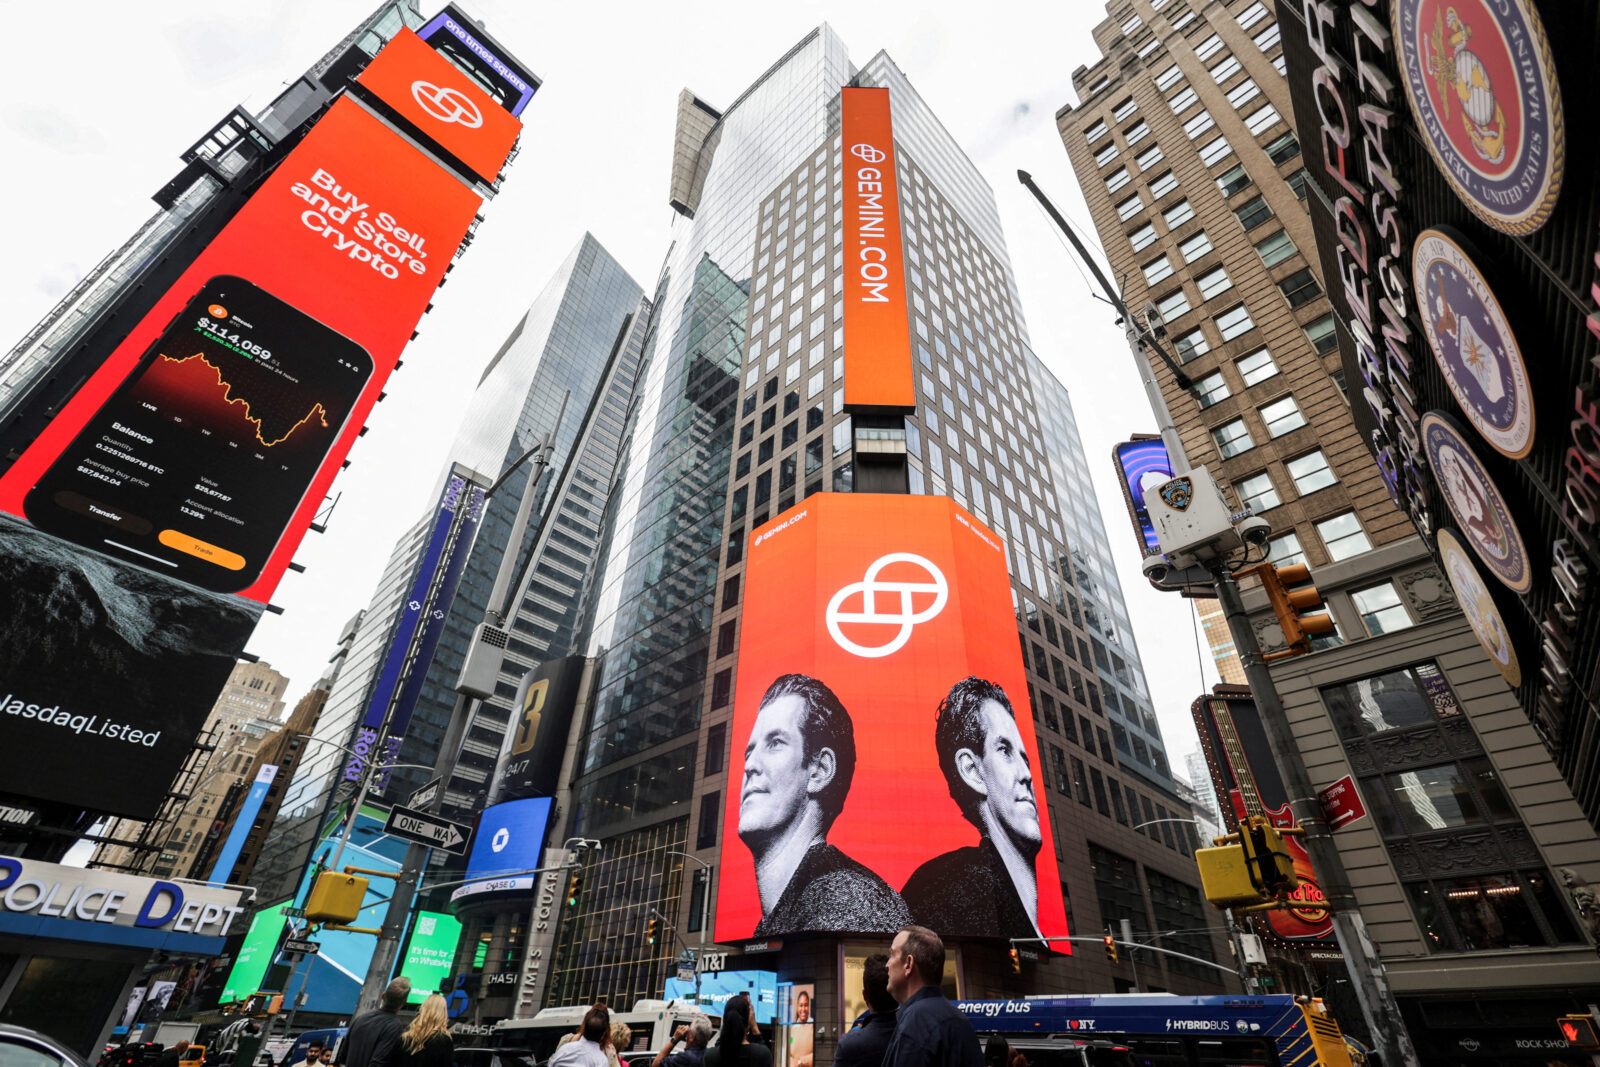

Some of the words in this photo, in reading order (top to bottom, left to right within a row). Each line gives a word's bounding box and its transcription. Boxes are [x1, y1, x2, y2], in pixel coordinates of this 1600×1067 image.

[446, 20, 466, 40] one
[466, 34, 494, 63] times
[492, 58, 526, 90] square
[1508, 21, 1542, 120] MARINE
[1403, 34, 1470, 186] DEPARTMENT
[1349, 0, 1400, 258] STATI
[1520, 131, 1542, 192] STATES
[1482, 184, 1522, 206] UNITED
[310, 168, 370, 218] Buy,
[375, 212, 428, 258] Sell,
[290, 182, 352, 224] and
[353, 220, 426, 275] Store
[858, 168, 889, 302] GEMINI.COM
[301, 210, 399, 279] Crypto
[1416, 248, 1430, 275] THE
[1429, 240, 1447, 257] AIR
[1451, 250, 1494, 312] FORCE
[232, 315, 254, 329] Bitcoin
[282, 372, 299, 384] hours
[142, 402, 158, 412] LIVE
[102, 435, 134, 452] Quantity
[112, 422, 154, 445] Balance
[83, 458, 115, 474] Average
[116, 470, 130, 481] buy
[130, 476, 150, 488] price
[148, 464, 165, 475] BTC
[200, 476, 219, 488] Value
[88, 504, 122, 522] Transfer
[184, 498, 214, 514] Account
[213, 508, 245, 526] allocation
[763, 510, 808, 540] GEMINI.COM
[512, 678, 550, 756] 3
[506, 760, 530, 778] 24/7
[0, 804, 34, 826] TION
[400, 817, 424, 834] ONE
[433, 826, 458, 843] WAY
[486, 880, 508, 890] CHASE
[0, 857, 128, 924] POLICE
[134, 880, 245, 937] DEPT
[520, 948, 542, 1008] TIMES
[536, 863, 560, 932] SQUAR
[408, 956, 419, 964] on
[422, 947, 438, 956] time
[438, 948, 448, 958] for
[695, 952, 728, 972] AT&T
[958, 1002, 1002, 1016] energy
[1006, 1000, 1031, 1013] bus
[1174, 1020, 1230, 1031] HYBRIDBUS
[1516, 1040, 1541, 1048] ROCK
